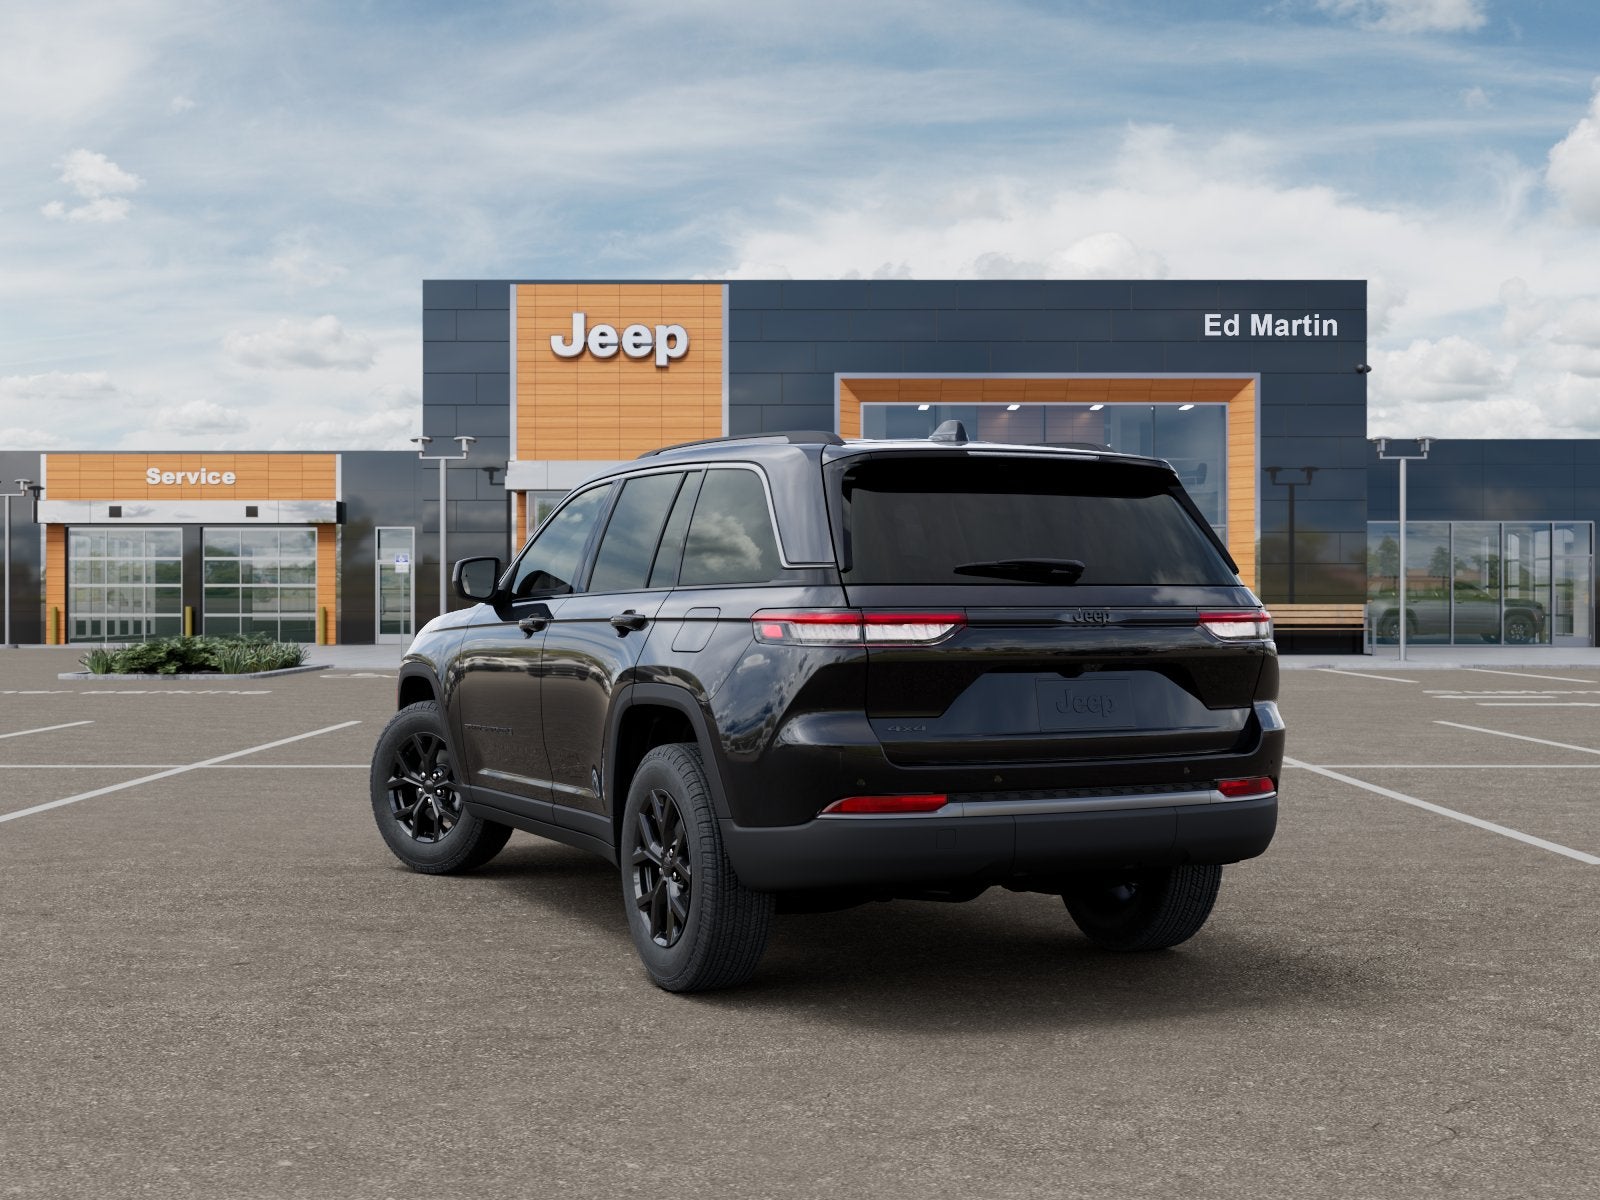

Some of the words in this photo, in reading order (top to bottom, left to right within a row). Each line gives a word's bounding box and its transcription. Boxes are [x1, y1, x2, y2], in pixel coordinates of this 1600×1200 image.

[1204, 313, 1240, 337] Ed
[1250, 313, 1338, 337] Martin
[550, 312, 689, 367] Jeep
[146, 467, 236, 485] Service
[1072, 608, 1111, 625] Jeep
[1055, 688, 1114, 718] Jeep
